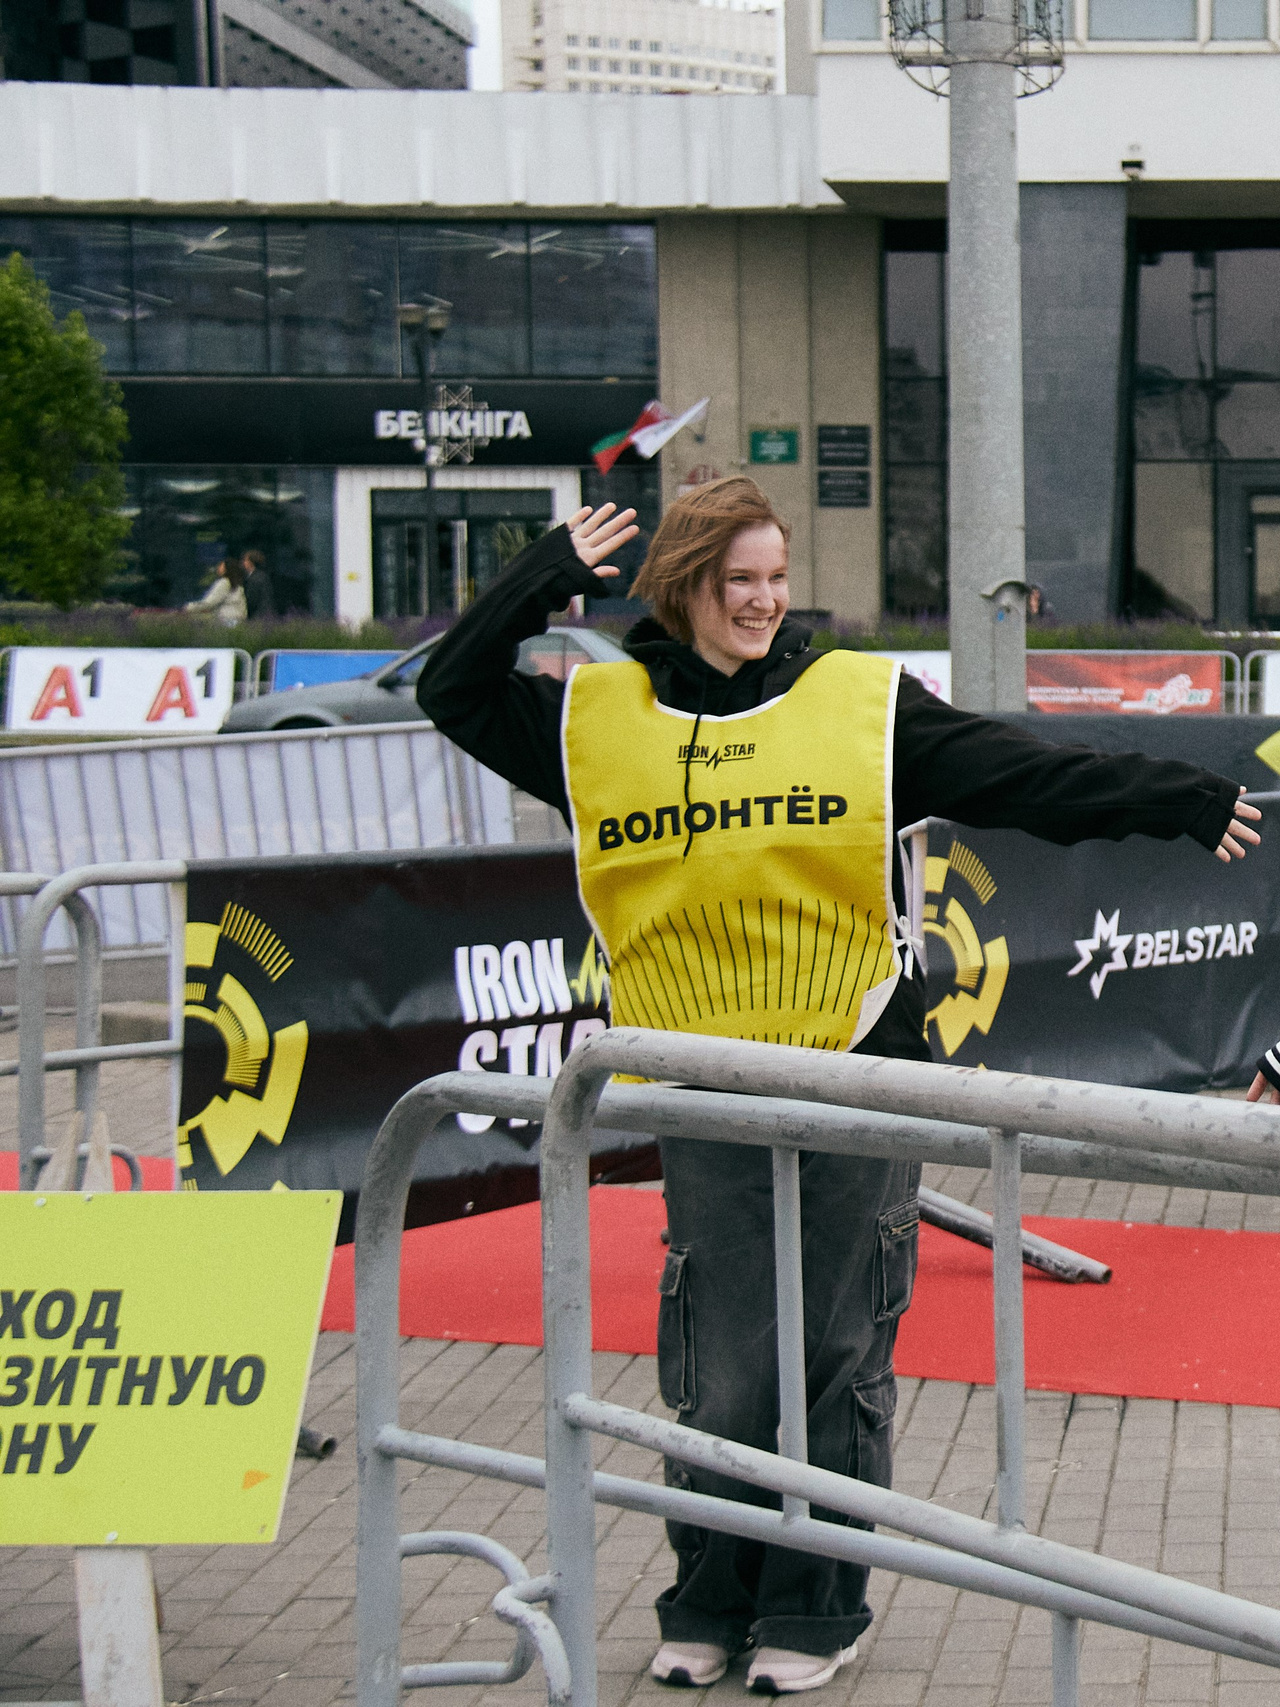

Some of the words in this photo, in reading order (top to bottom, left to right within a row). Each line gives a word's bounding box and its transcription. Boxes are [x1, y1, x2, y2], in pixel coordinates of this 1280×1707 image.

[677, 744, 710, 759] IRON
[723, 742, 756, 758] STAR
[598, 785, 848, 851] ВОЛОНТЁР
[1132, 921, 1259, 970] BELSTAR
[454, 937, 573, 1024] IRON
[458, 1018, 607, 1134] STA
[0, 1288, 124, 1350] ХОД
[0, 1353, 266, 1407] ЗИТНУЮ
[0, 1422, 97, 1475] НУ
